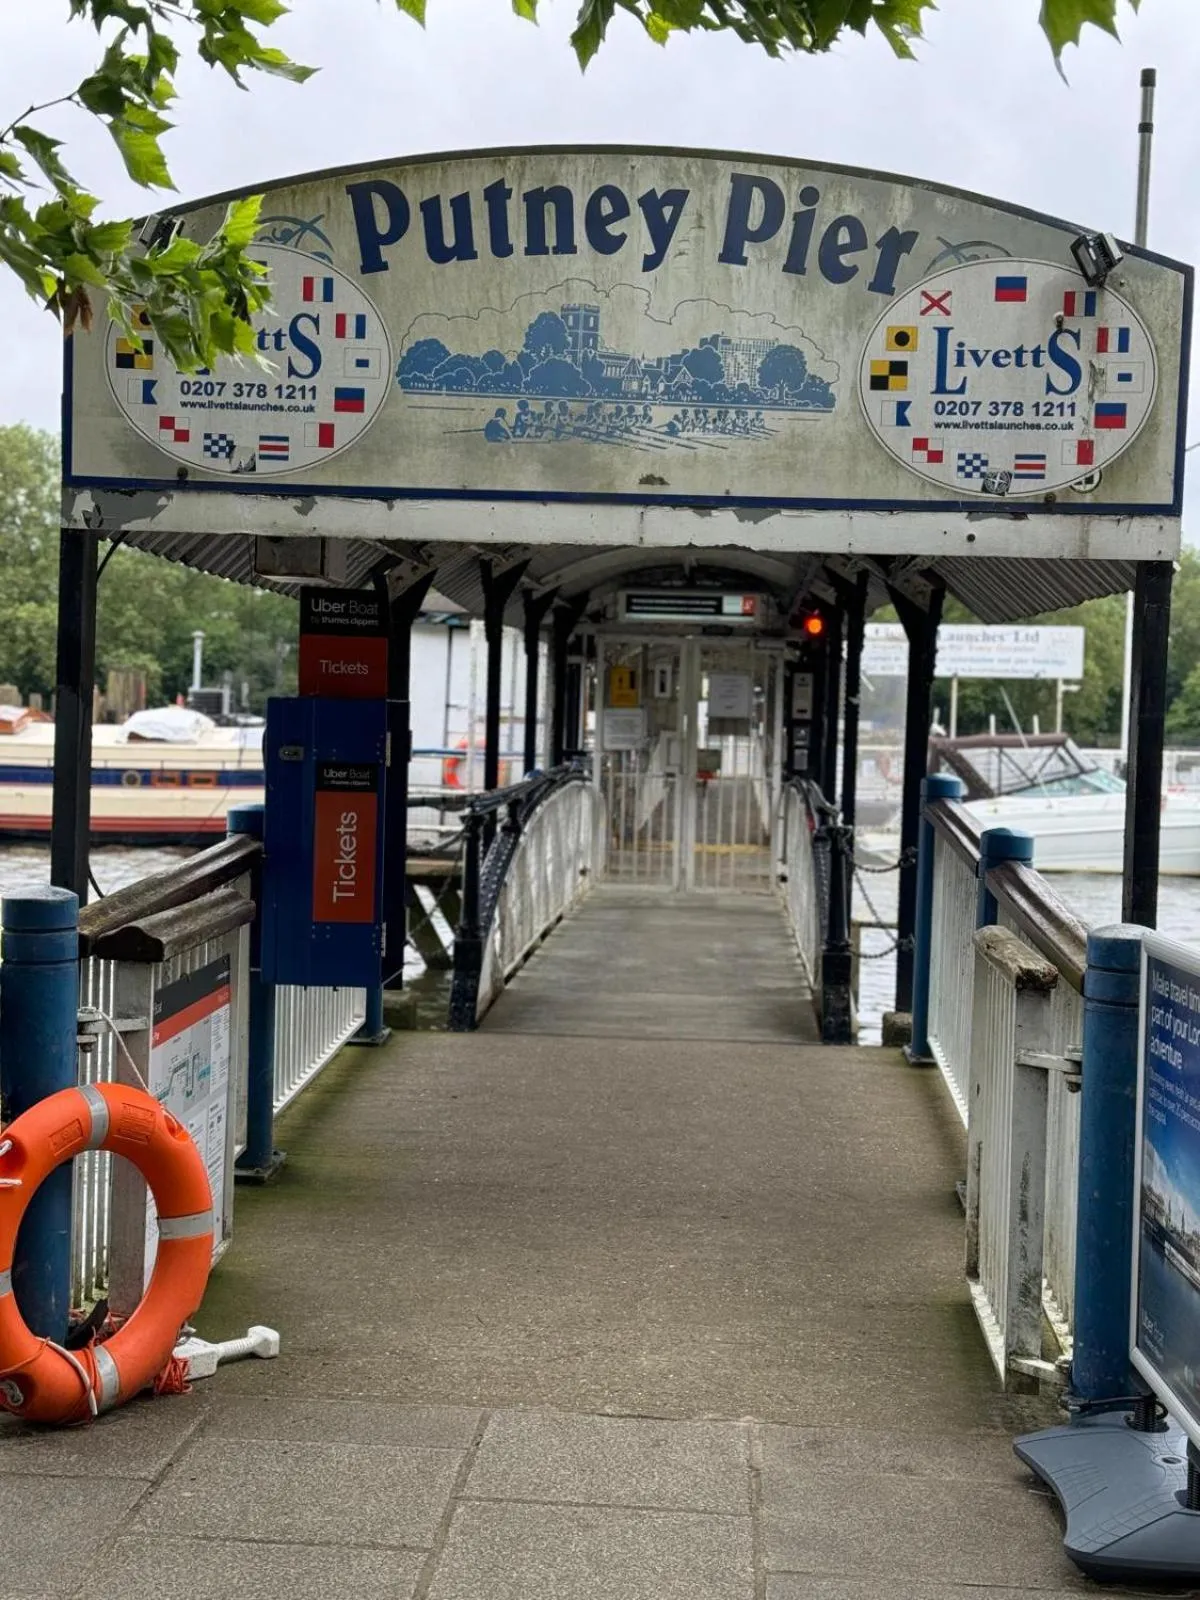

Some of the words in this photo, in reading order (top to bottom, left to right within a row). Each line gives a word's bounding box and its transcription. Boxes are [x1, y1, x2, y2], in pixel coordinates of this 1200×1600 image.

[345, 177, 690, 275] Putney
[718, 172, 919, 297] Pier
[180, 381, 227, 396] 0207
[233, 383, 267, 399] 378
[274, 384, 317, 400] 1211
[180, 400, 316, 413] www.livettslaunches.co.uk
[934, 400, 982, 416] 0207
[988, 401, 1024, 417] 378
[1032, 402, 1076, 417] 1211
[934, 420, 1074, 431] www.livettslaunches.co.uk
[311, 598, 346, 613] Uber
[349, 600, 379, 615] Boat
[321, 616, 349, 625] thames
[350, 617, 380, 627] clippers
[1014, 630, 1040, 643] Ltd
[319, 660, 369, 675] Tickets
[324, 767, 348, 778] Uber
[349, 768, 371, 780] Boat
[332, 811, 358, 903] Tickets
[1152, 969, 1170, 998] Make
[1170, 979, 1189, 1007] travel
[1151, 1005, 1165, 1028] part
[1165, 1007, 1173, 1031] of
[1172, 1016, 1188, 1039] your
[1150, 1034, 1183, 1070] adventure
